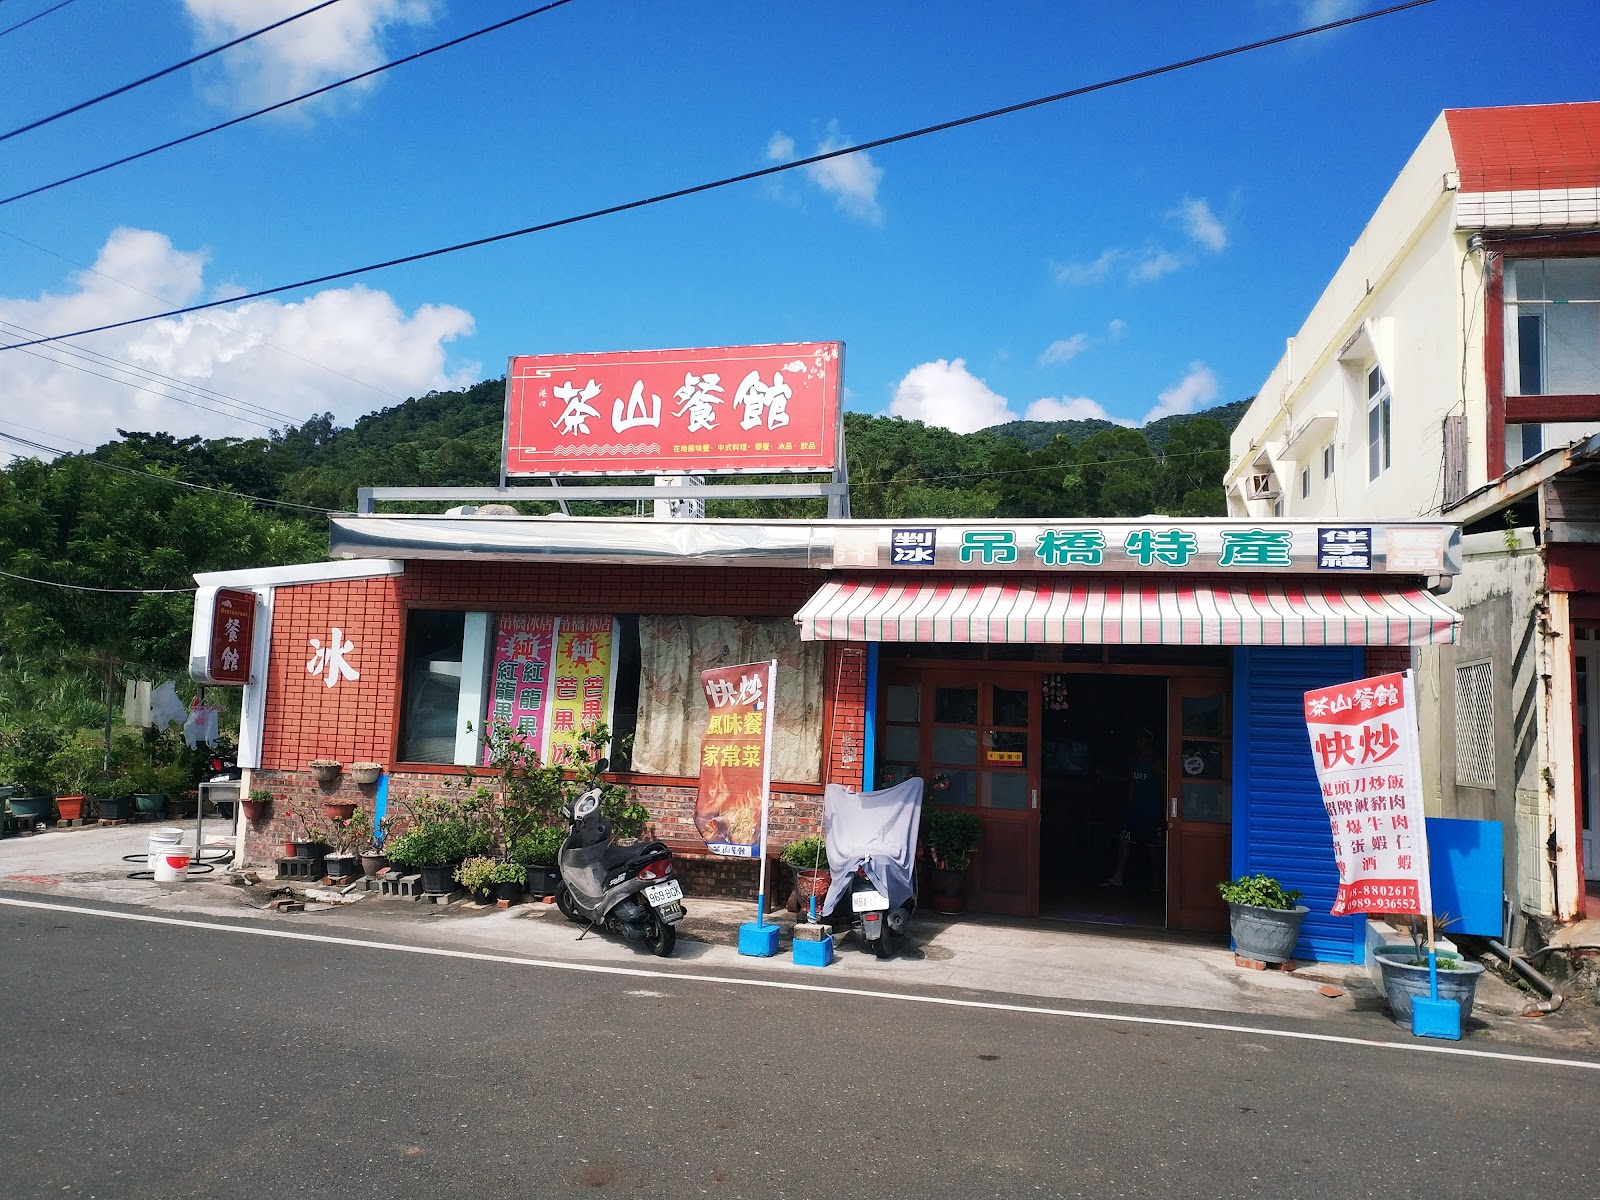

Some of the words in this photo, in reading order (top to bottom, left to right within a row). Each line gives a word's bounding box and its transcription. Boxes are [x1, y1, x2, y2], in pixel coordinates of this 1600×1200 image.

[549, 371, 792, 437] 茶山餐館
[777, 441, 793, 450] 冰品
[799, 440, 816, 450] 飲品
[959, 529, 1294, 568] 吊橋特產
[1320, 530, 1370, 567] 伴手禮
[499, 613, 553, 632] 吊橋冰店
[560, 614, 611, 632] 吊橋冰店
[221, 617, 241, 671] 餐館
[512, 637, 534, 661] 純
[570, 637, 594, 662] 純
[306, 627, 360, 688] 冰
[706, 674, 763, 708] 快炒
[1308, 683, 1399, 718] 茶山餐館
[551, 675, 579, 766] 芒果冰
[706, 712, 763, 736] 風味餐
[703, 745, 761, 768] 家常菜
[1315, 722, 1400, 769] 快炒
[1322, 773, 1405, 797] 鬼頭刀炒飯
[649, 885, 682, 904] 969-BGK
[1347, 898, 1417, 911] 0989-936552
